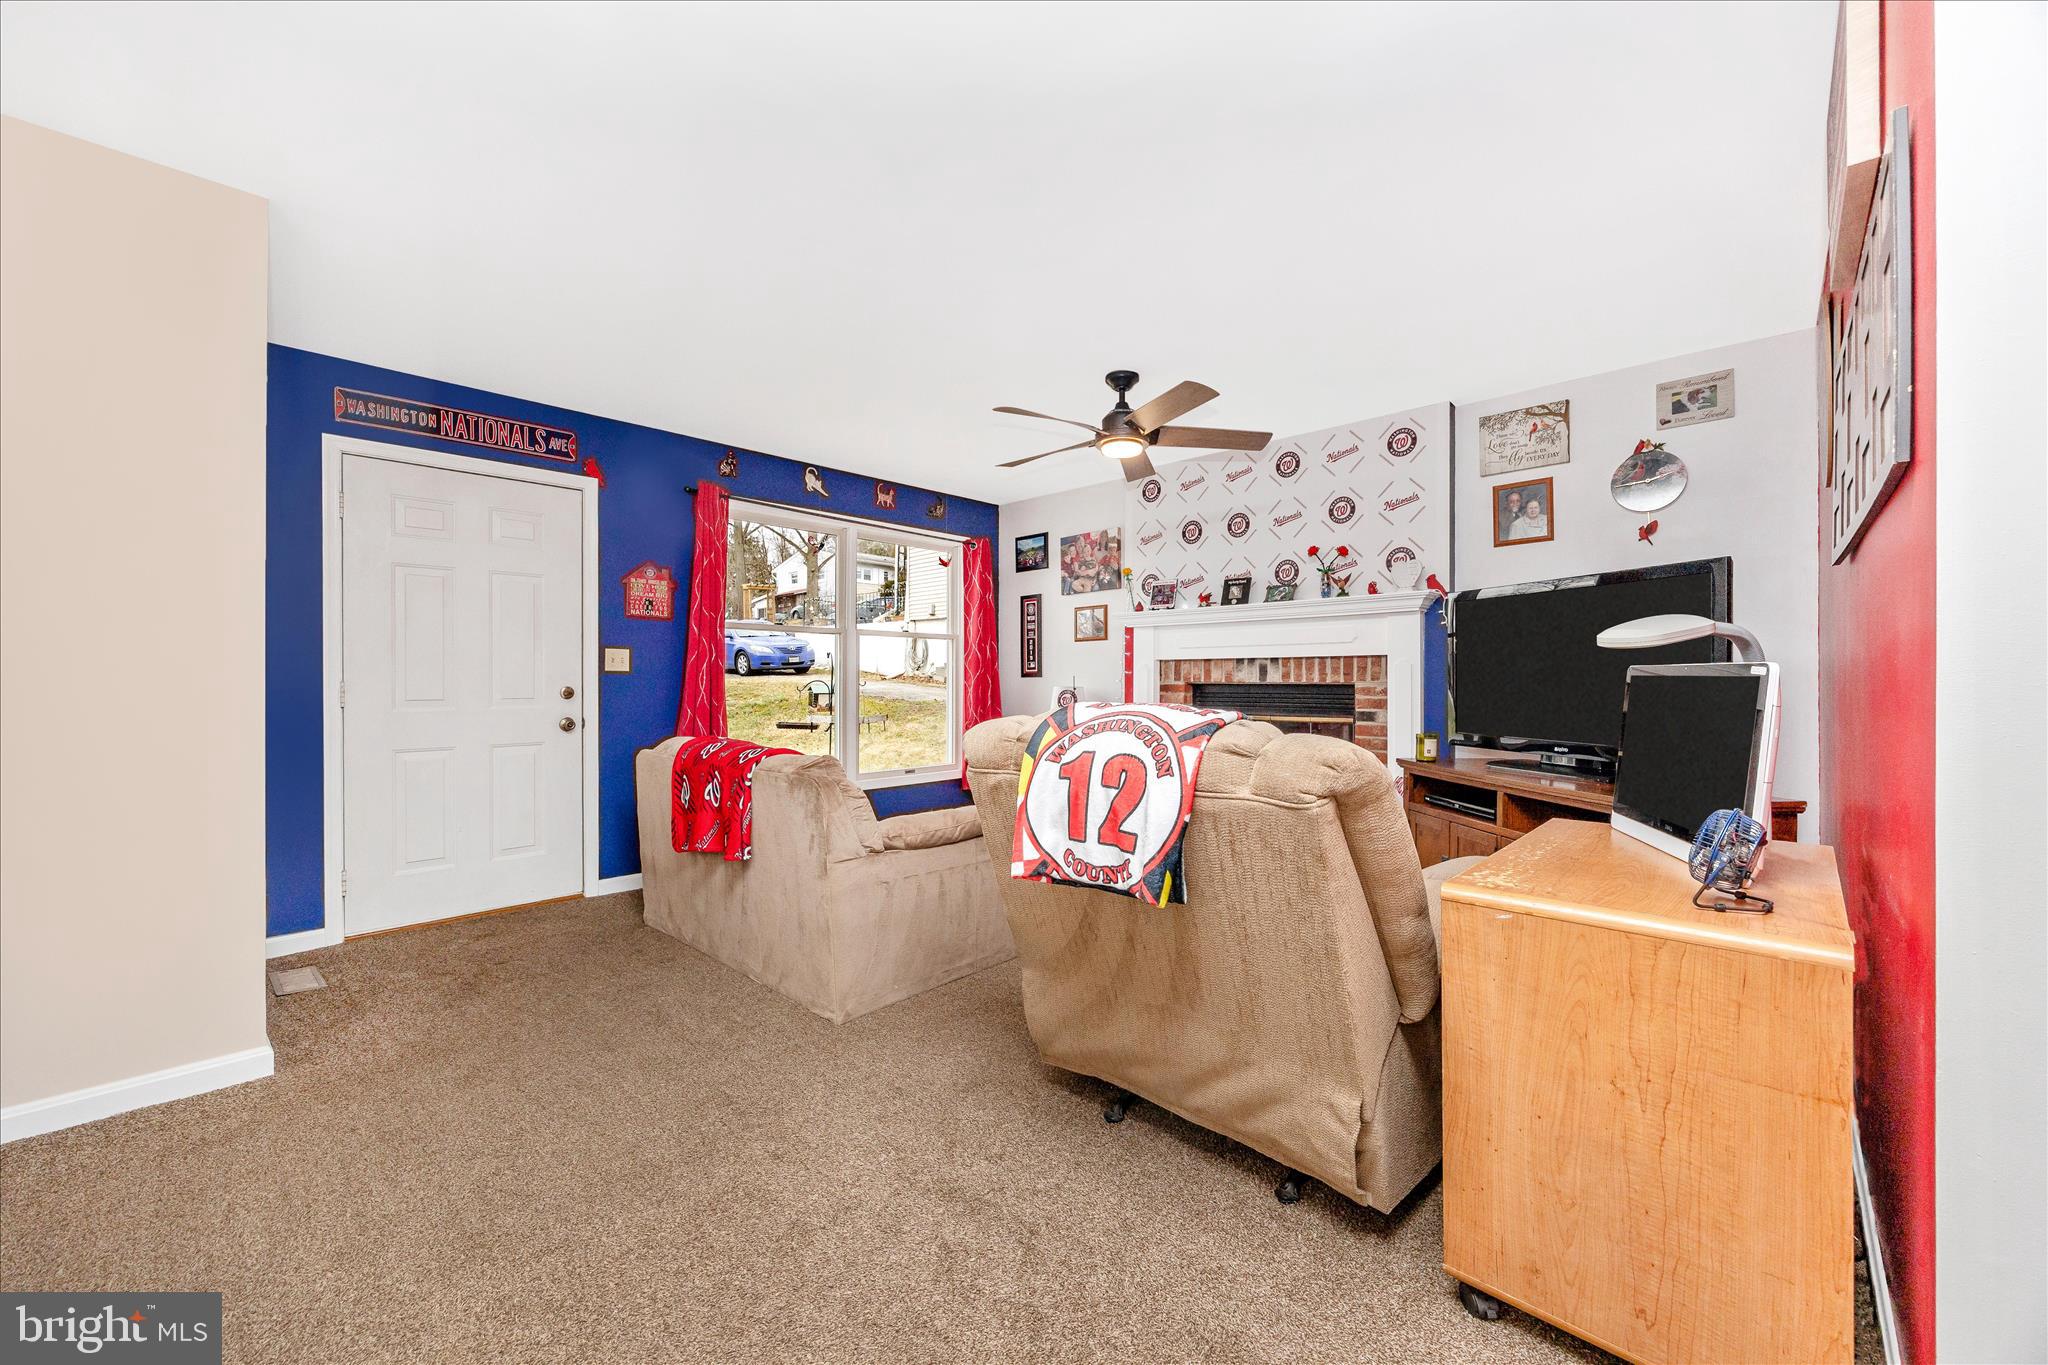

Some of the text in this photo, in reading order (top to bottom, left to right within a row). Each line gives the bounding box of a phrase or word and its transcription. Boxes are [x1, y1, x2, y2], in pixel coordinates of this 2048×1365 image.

[346, 398, 568, 452] WASHINGTON NATIONALS AVE
[1326, 443, 1360, 462] Nationals
[1226, 466, 1253, 482] Nationals
[1180, 476, 1205, 492] Nationals
[1384, 492, 1420, 511] Nationals
[1273, 510, 1302, 527] Nationals
[1180, 574, 1204, 588] Nationals
[1046, 718, 1174, 779] WASHINGTON
[1058, 750, 1148, 855] 12
[1064, 848, 1133, 884] COUNTY
